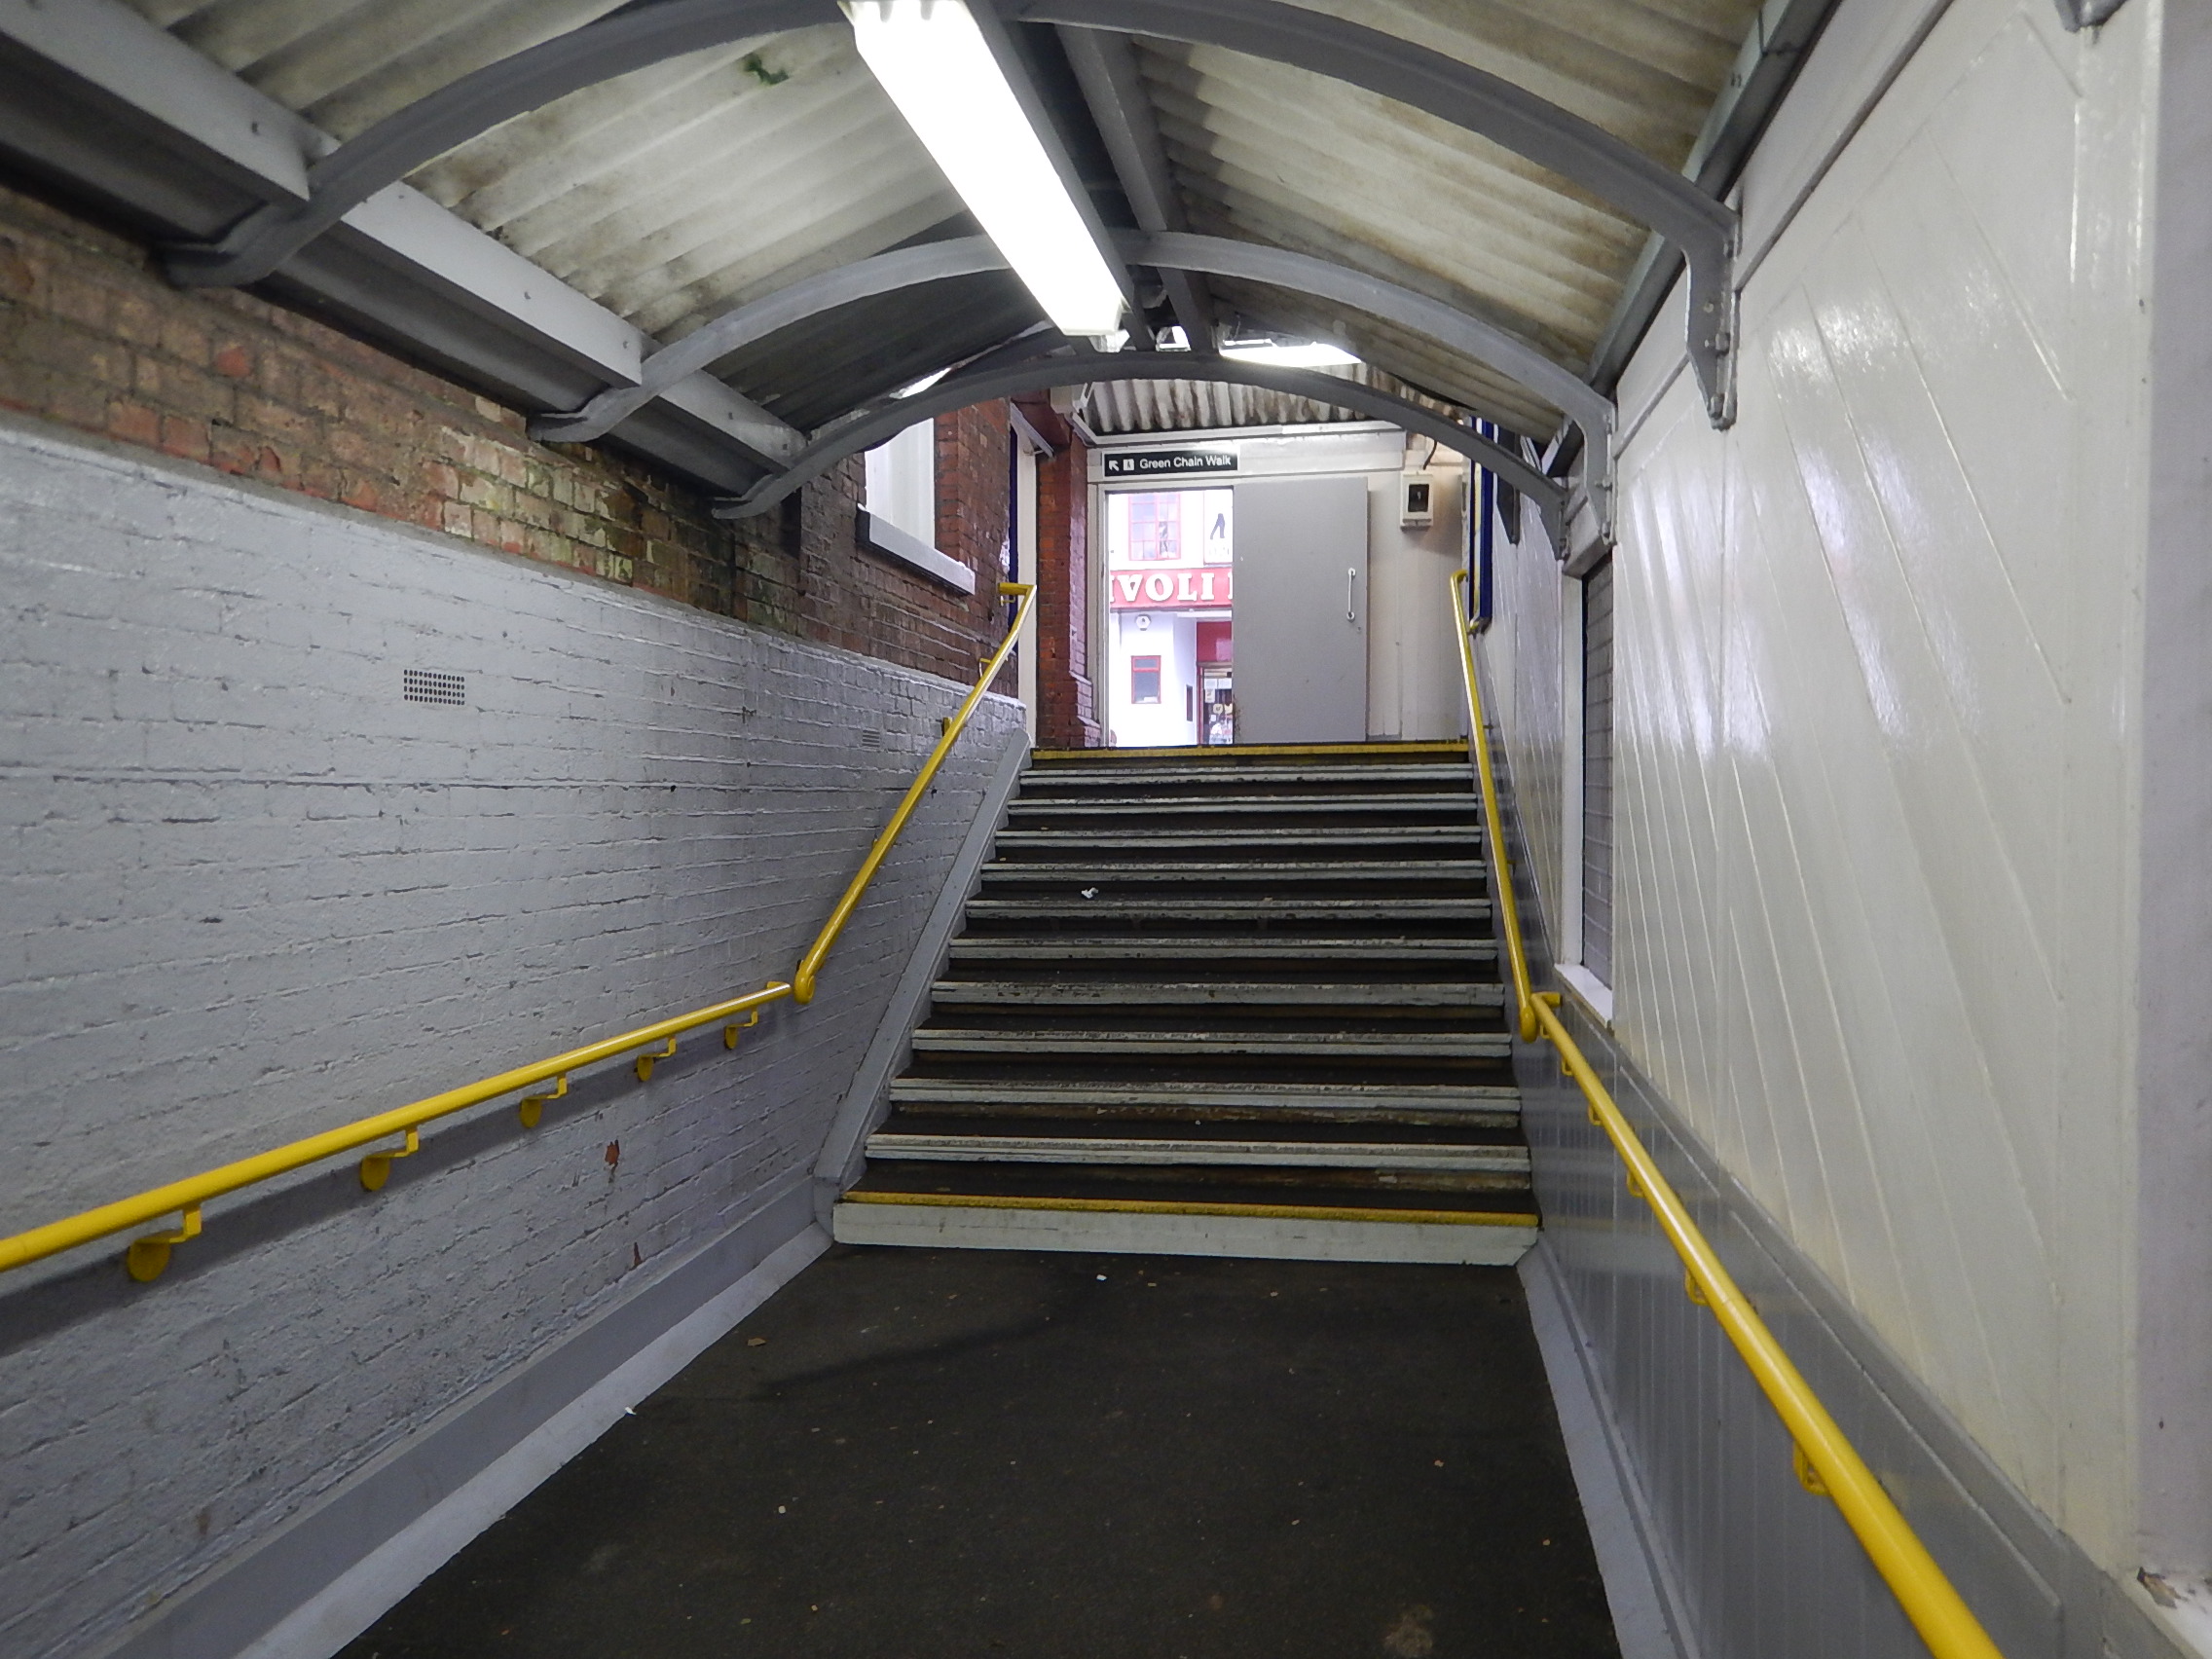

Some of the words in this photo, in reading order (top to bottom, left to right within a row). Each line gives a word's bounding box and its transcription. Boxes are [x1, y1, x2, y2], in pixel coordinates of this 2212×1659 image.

[1140, 459, 1171, 469] Green
[1173, 456, 1203, 467] Chain
[1205, 455, 1232, 466] Walk
